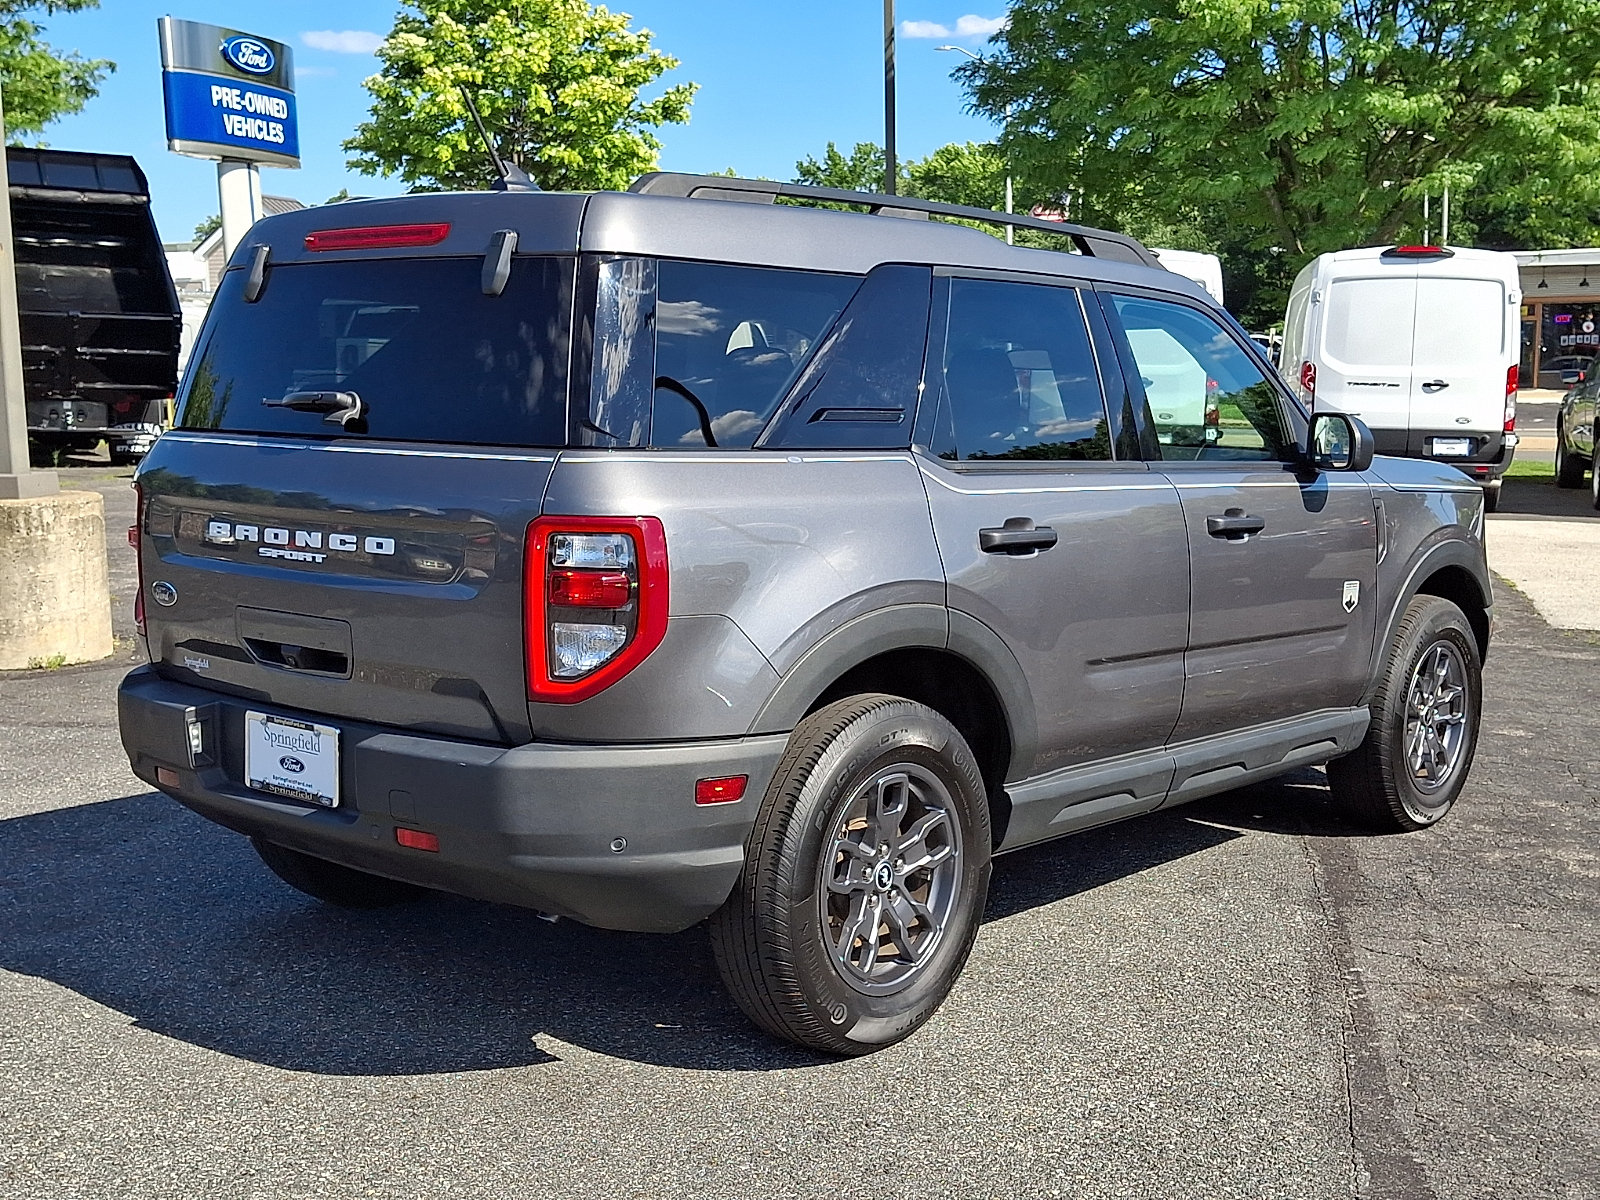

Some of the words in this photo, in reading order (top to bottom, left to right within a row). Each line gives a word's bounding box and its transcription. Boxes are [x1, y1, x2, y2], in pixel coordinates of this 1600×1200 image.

[238, 42, 268, 68] Ford
[210, 84, 288, 119] PRE-OWNED
[222, 113, 285, 144] VEHICLES
[208, 520, 396, 556] BRONCO
[258, 546, 328, 564] SPORT
[263, 725, 321, 754] Springfield
[282, 757, 301, 772] Ford
[268, 784, 313, 801] Springfield
